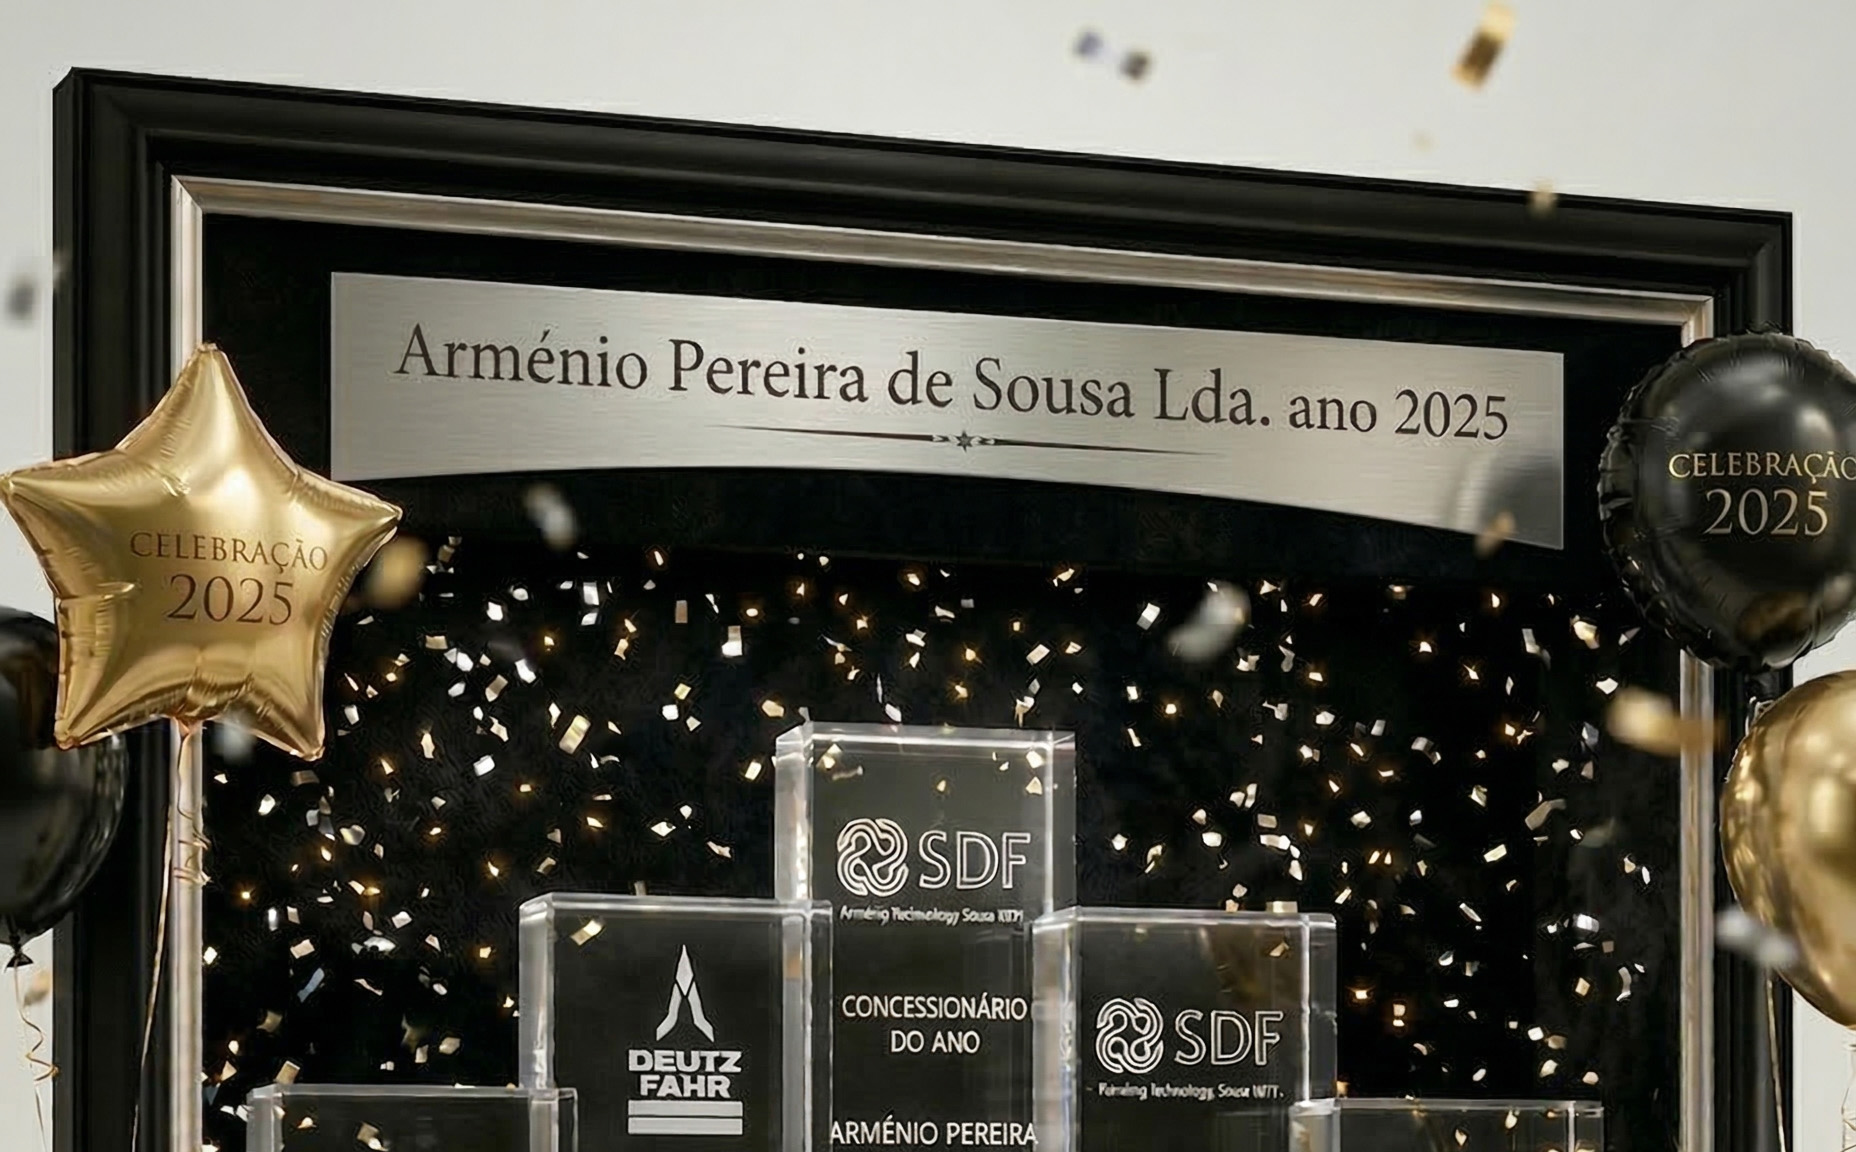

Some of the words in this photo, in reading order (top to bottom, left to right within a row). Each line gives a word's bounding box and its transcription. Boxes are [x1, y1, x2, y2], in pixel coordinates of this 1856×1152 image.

[391, 321, 648, 390] Arménio
[668, 338, 869, 403] Pereira
[887, 350, 953, 408] de
[972, 357, 1136, 419] Sousa
[1153, 367, 1271, 427] Lda.
[1288, 395, 1378, 433] ano
[1394, 388, 1509, 441] 2025
[1668, 450, 1856, 485] CELEBRAÇÃO
[1703, 488, 1829, 536] 2025
[130, 532, 328, 574] CELEBRAÇÃO
[167, 573, 294, 625] 2025
[918, 829, 1032, 890] SDF
[842, 991, 1028, 1021] CONCESSIONÁRIO
[891, 1029, 925, 1053] DO
[931, 1030, 981, 1054] ANO
[1174, 1009, 1284, 1066] SDF
[628, 1049, 742, 1073] DEUTZ
[640, 1073, 731, 1099] FAHR
[831, 1114, 939, 1145] ARMÉNIO
[946, 1119, 1040, 1147] PEREIRA
